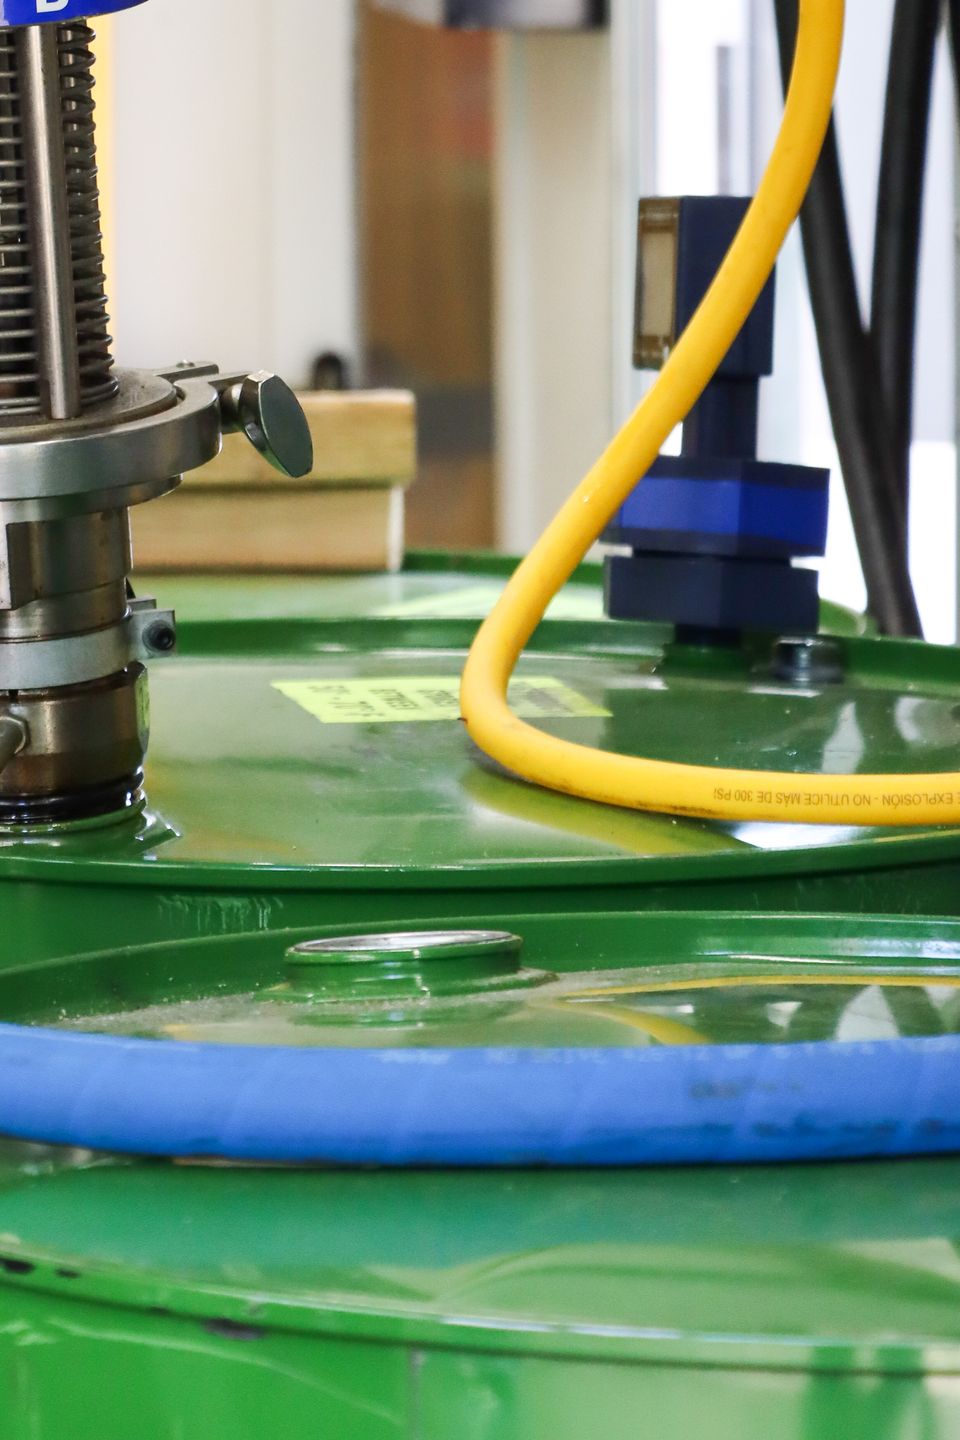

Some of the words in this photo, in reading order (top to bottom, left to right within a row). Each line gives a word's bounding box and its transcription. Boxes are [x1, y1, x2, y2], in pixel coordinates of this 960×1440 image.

[734, 788, 753, 802] 300
[756, 789, 773, 804] DE
[804, 791, 850, 807] UTILICE
[852, 792, 872, 807] NO
[882, 791, 954, 810] EXPLOSIÓN
